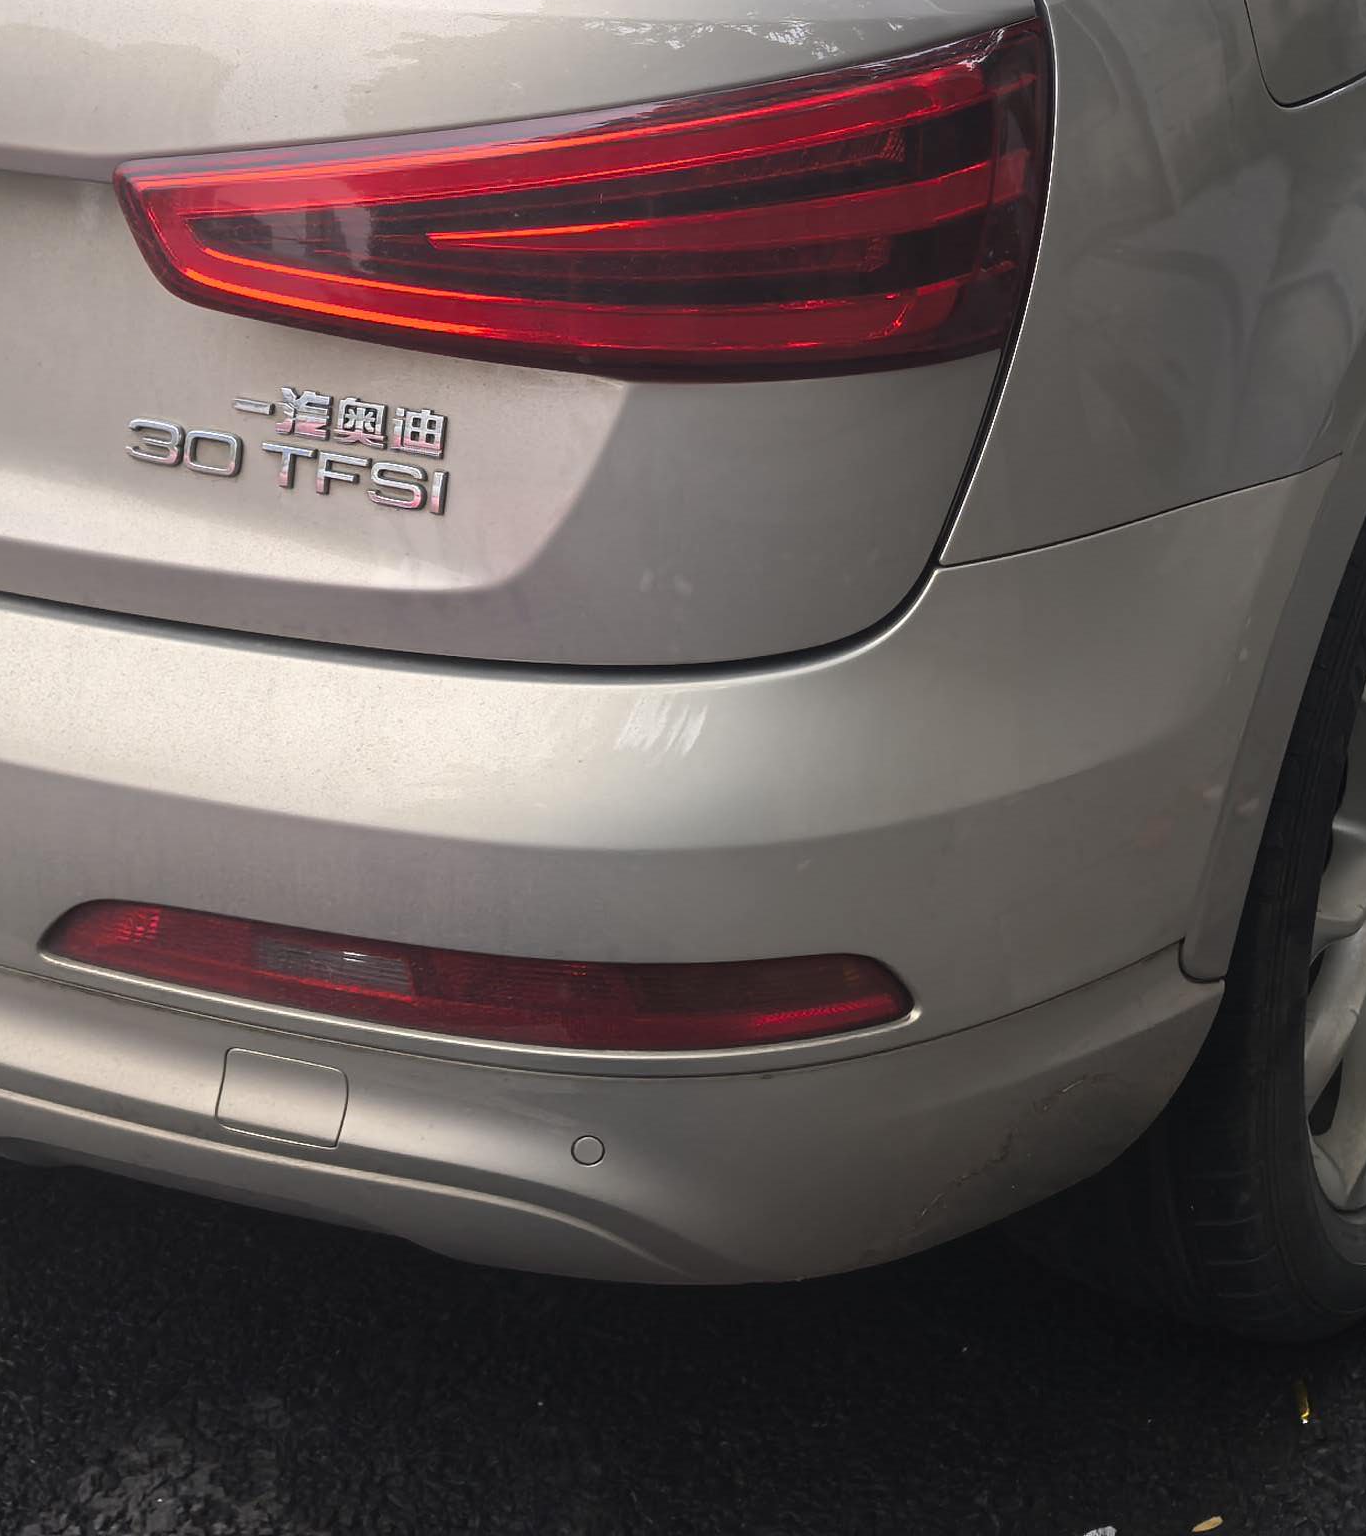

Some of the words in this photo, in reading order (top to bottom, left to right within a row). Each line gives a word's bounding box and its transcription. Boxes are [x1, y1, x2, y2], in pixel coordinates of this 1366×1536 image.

[125, 416, 245, 479] 30
[261, 440, 450, 516] TFSI
[231, 386, 449, 460] 一汽奥迪
